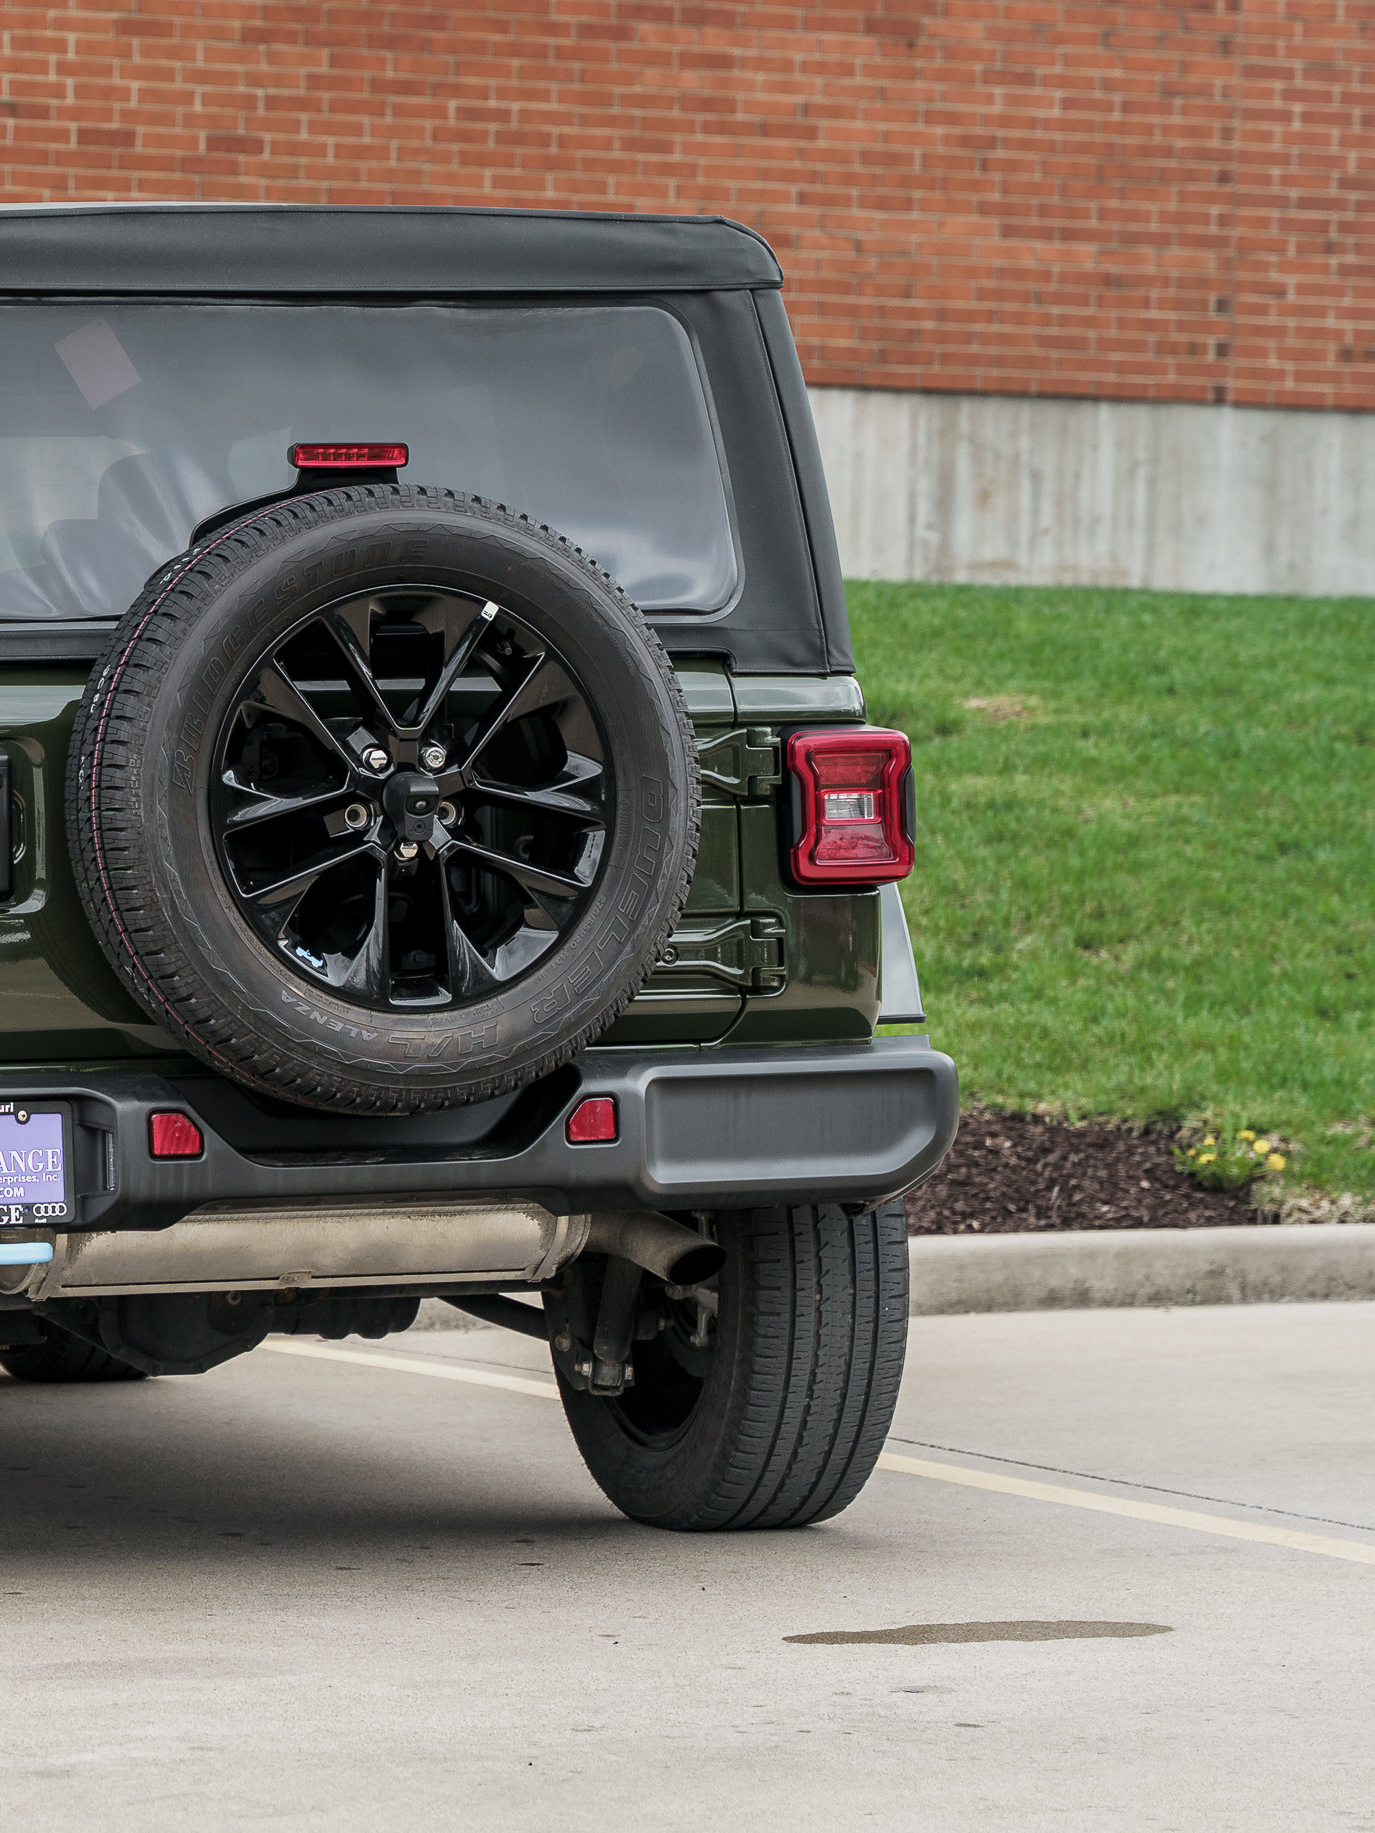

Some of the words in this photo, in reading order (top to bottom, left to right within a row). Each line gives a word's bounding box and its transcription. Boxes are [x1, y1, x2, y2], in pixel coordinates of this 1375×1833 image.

[171, 539, 428, 795] BRIDGESTONE
[530, 775, 664, 1024] DUELER
[281, 990, 379, 1042] ALENZA
[43, 1173, 60, 1181] Inc.
